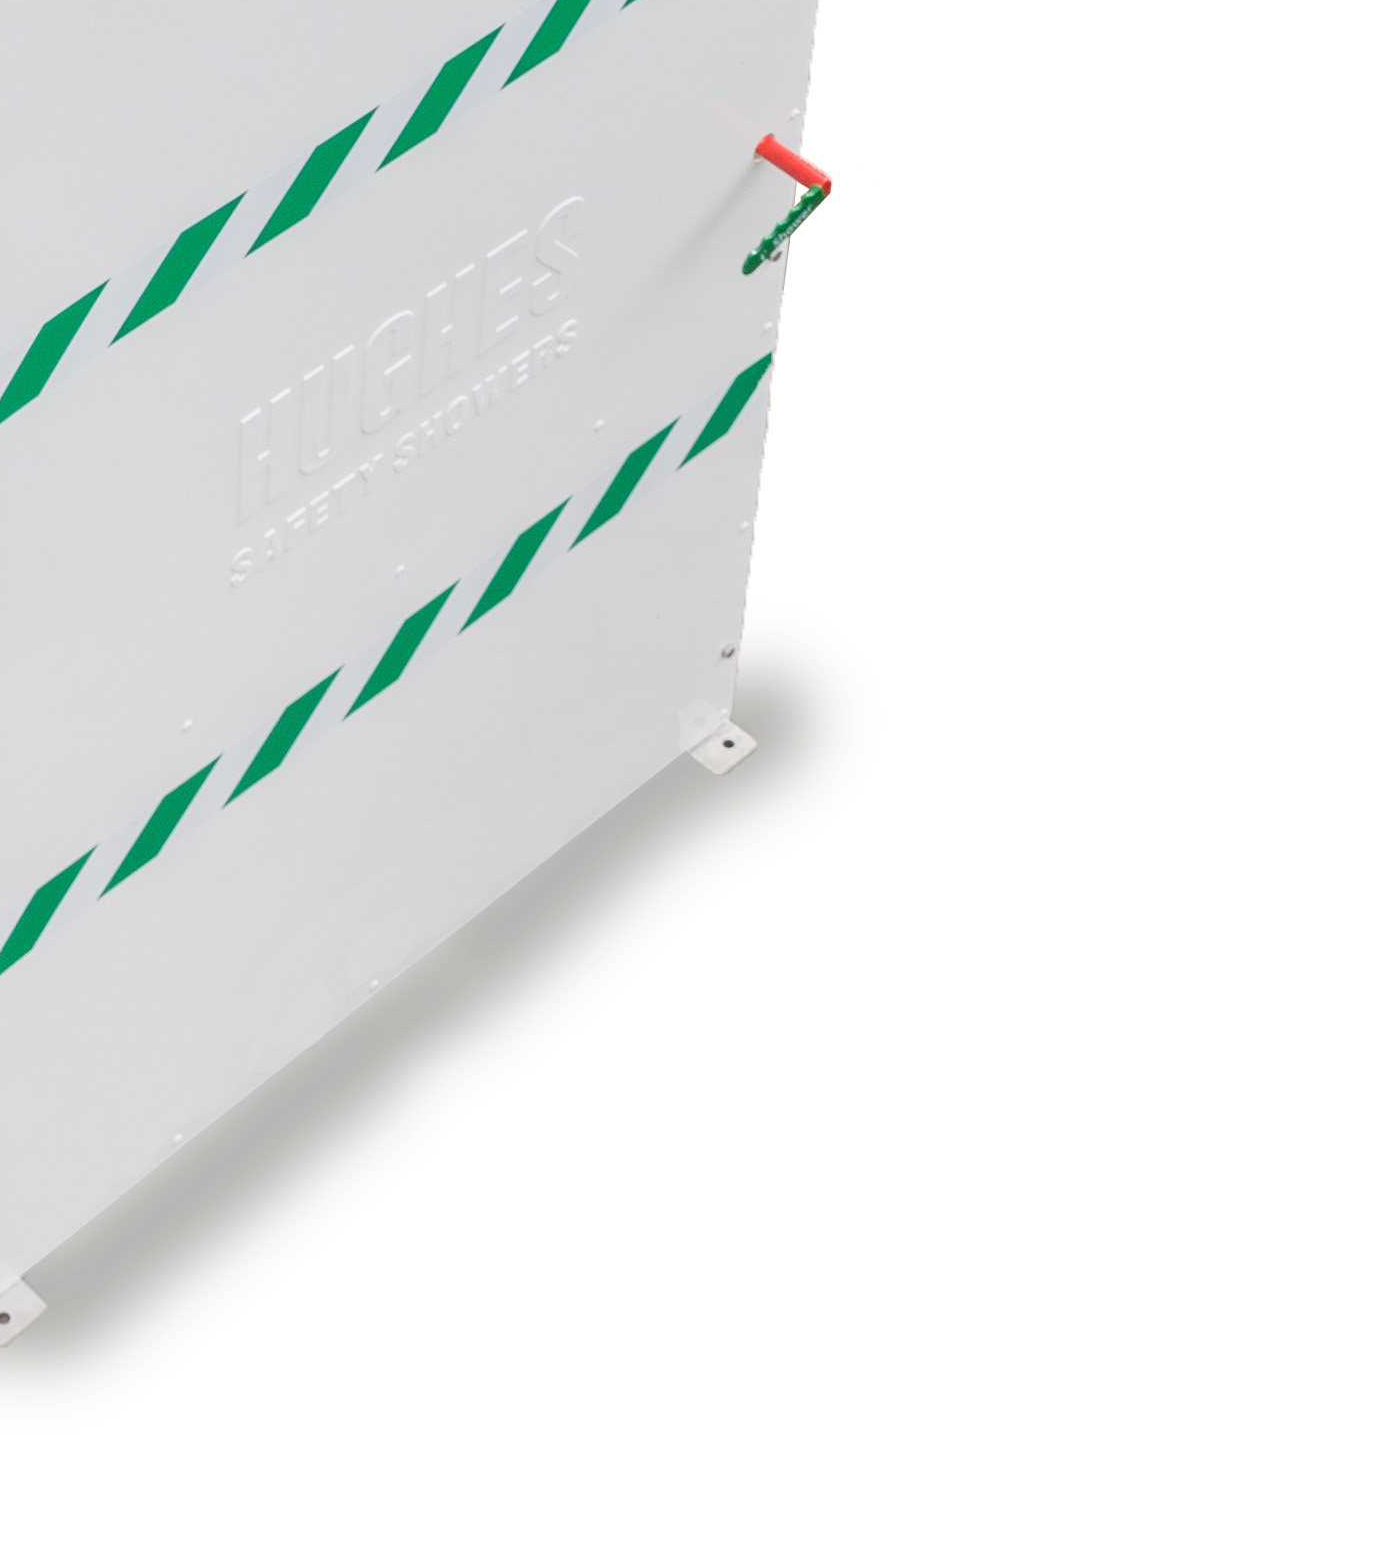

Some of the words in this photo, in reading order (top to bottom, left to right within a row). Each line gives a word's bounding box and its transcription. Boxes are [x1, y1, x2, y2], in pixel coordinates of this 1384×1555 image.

[230, 453, 384, 589] SAFETY
[392, 318, 578, 474] SHOWERS
[237, 195, 585, 525] HUGHES
